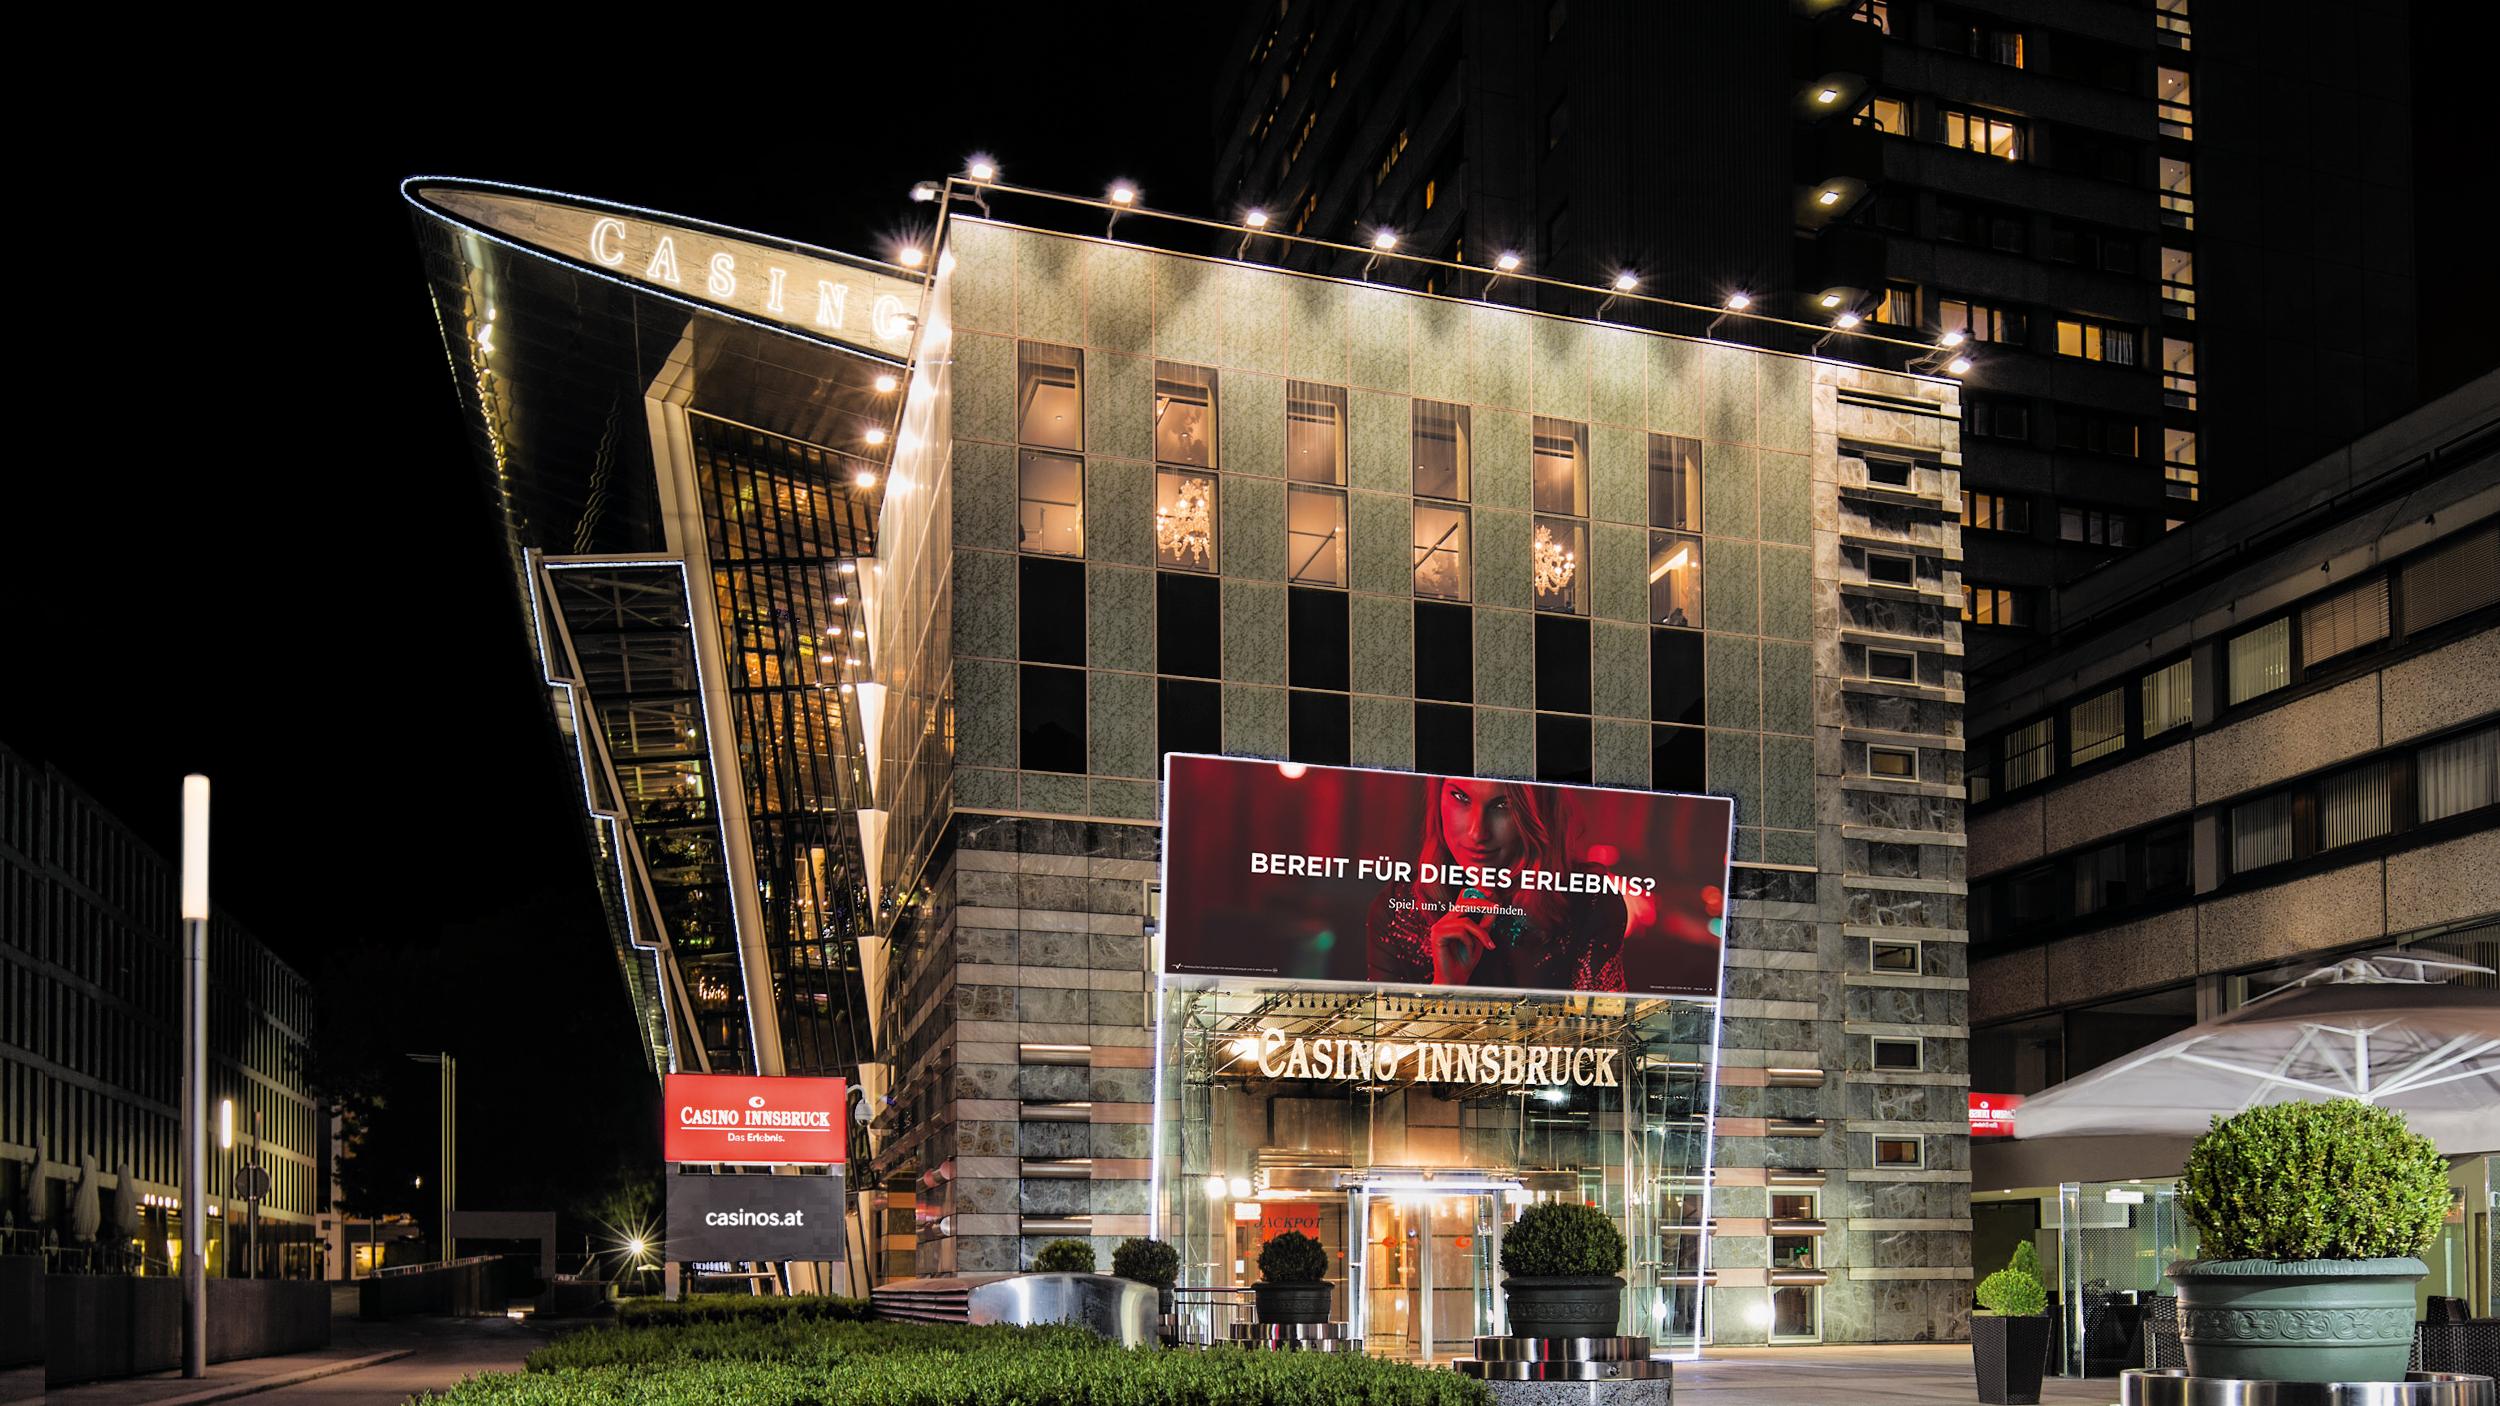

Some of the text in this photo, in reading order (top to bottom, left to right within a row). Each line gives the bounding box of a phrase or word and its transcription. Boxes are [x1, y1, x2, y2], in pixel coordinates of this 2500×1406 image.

[590, 217, 908, 340] CASINO
[1251, 852, 1657, 897] BEREIT FÜR DIESES ERLEBNIS?
[1388, 897, 1419, 912] Spiel,
[1448, 901, 1528, 916] herauszufinden.
[1258, 1028, 1619, 1088] CASINO INNSBRUCK
[680, 1106, 831, 1127] CASINO INNSBRUCK
[727, 1132, 786, 1143] Das Erlebnis.
[705, 1208, 804, 1227] casinos.at
[1254, 1215, 1323, 1229] JACKPOT
